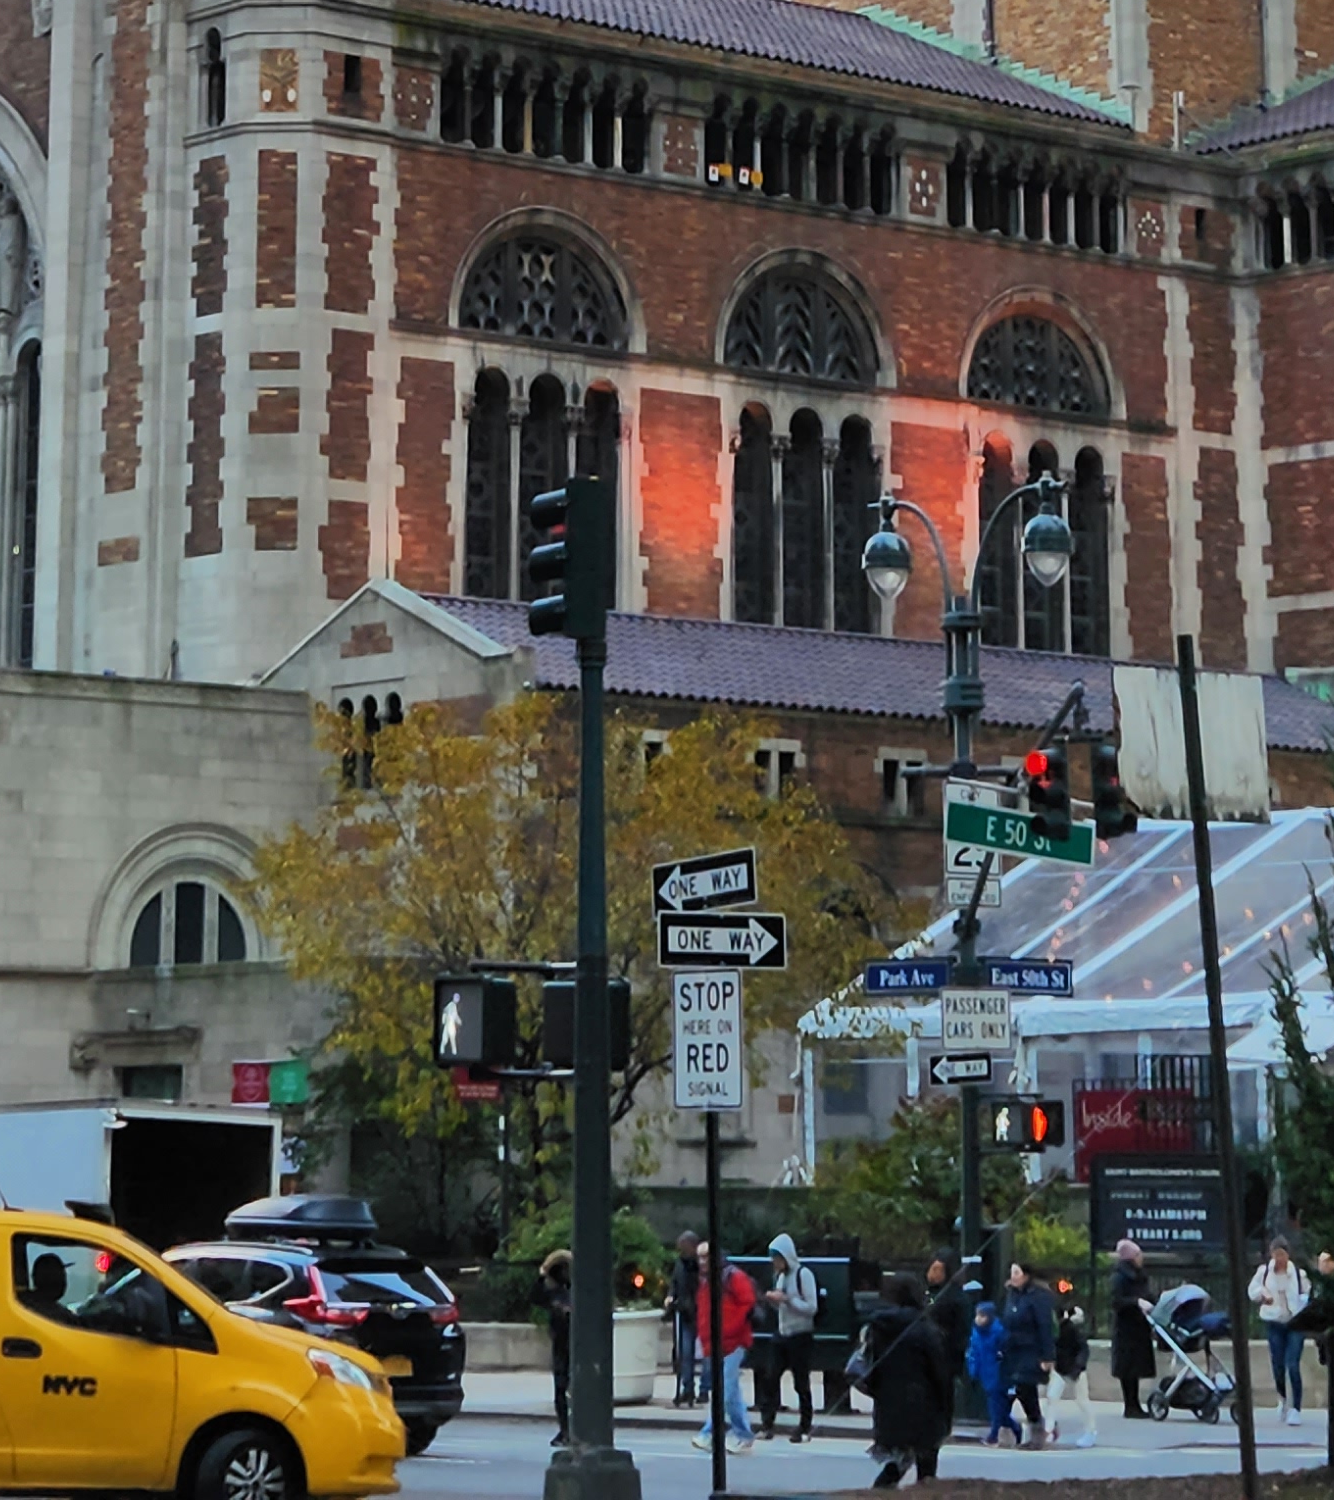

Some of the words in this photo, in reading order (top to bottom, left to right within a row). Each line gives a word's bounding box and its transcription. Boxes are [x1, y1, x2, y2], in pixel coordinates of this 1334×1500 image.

[986, 815, 998, 842] E
[1004, 819, 1027, 847] 50
[668, 876, 698, 899] ONE
[710, 867, 742, 891] WAY
[677, 930, 712, 950] ONE
[728, 931, 765, 952] WAY
[879, 968, 909, 986] Park
[911, 968, 935, 986] Ave
[991, 967, 1018, 986] East
[1022, 969, 1049, 988] 50th
[1052, 970, 1065, 988] St
[679, 981, 734, 1012] STOP
[946, 997, 1007, 1015] PASSENGER
[683, 1019, 712, 1035] HERE
[717, 1018, 733, 1034] ON
[946, 1021, 974, 1039] CARS
[981, 1022, 1007, 1039] ONLY
[687, 1043, 730, 1073] RED
[965, 1061, 985, 1074] WAY
[687, 1082, 729, 1097] SIGNAL
[43, 1376, 98, 1397] NYC
